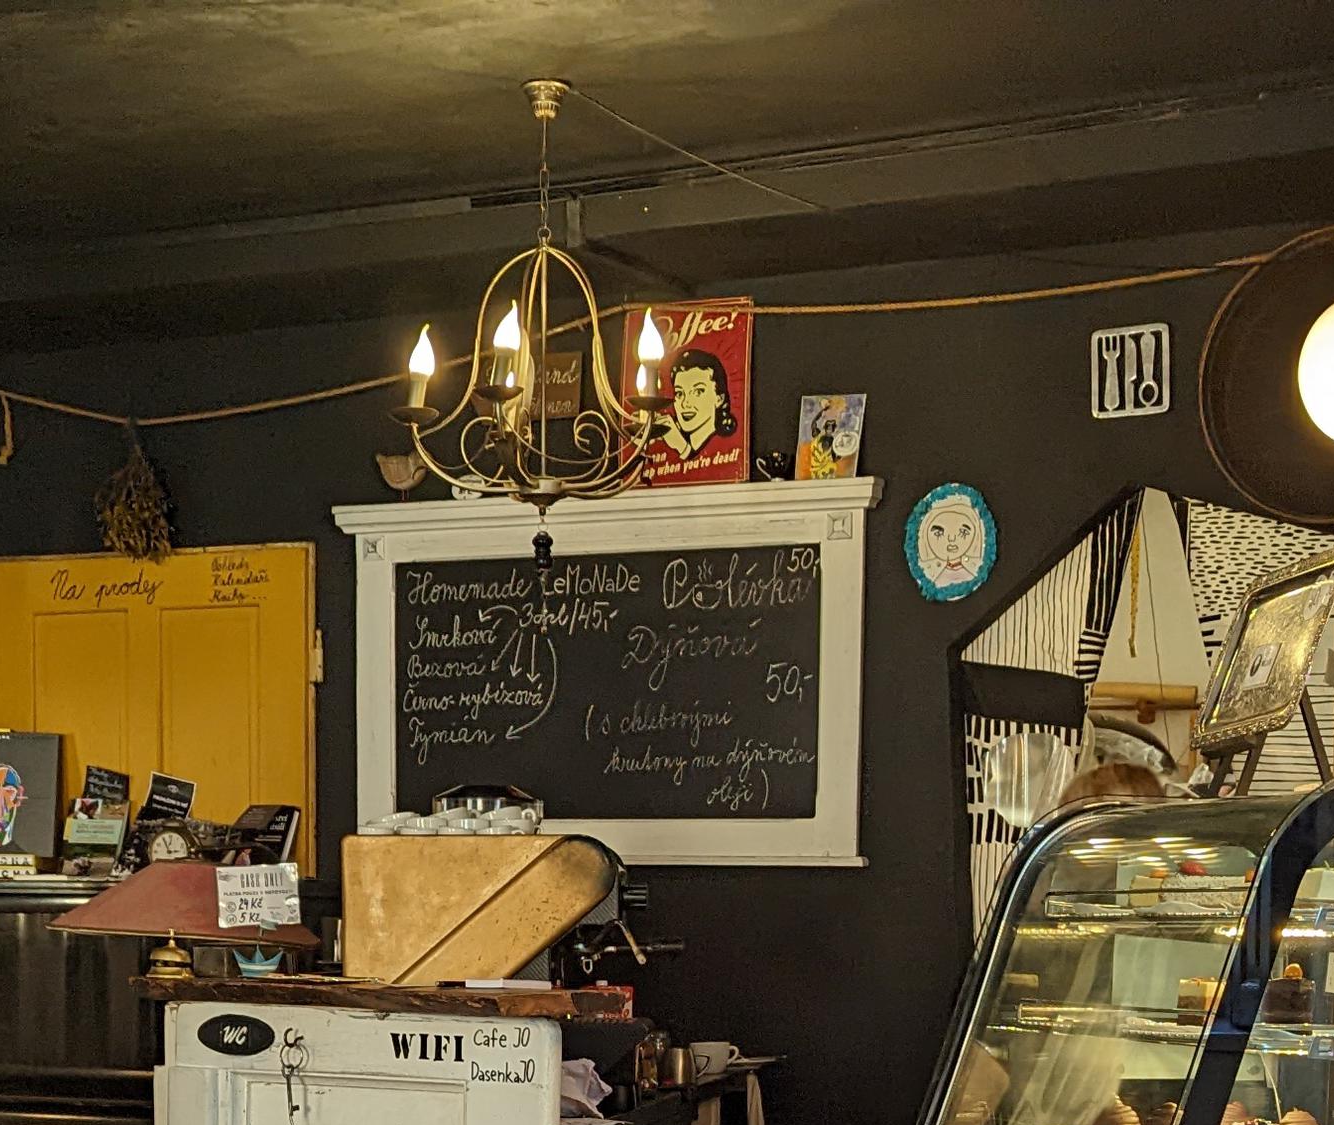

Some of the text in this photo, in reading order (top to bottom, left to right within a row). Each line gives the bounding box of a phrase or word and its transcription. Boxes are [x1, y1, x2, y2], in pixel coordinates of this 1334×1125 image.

[657, 461, 681, 476] when
[683, 456, 711, 474] you're
[713, 448, 739, 465] dead!
[50, 567, 164, 608] Na prodej
[406, 564, 640, 605] Homemade LeMoNaDe
[766, 662, 814, 703] 50,-
[222, 1025, 248, 1045] WC
[389, 1032, 465, 1063] WIFI
[473, 1028, 508, 1048] Cafe
